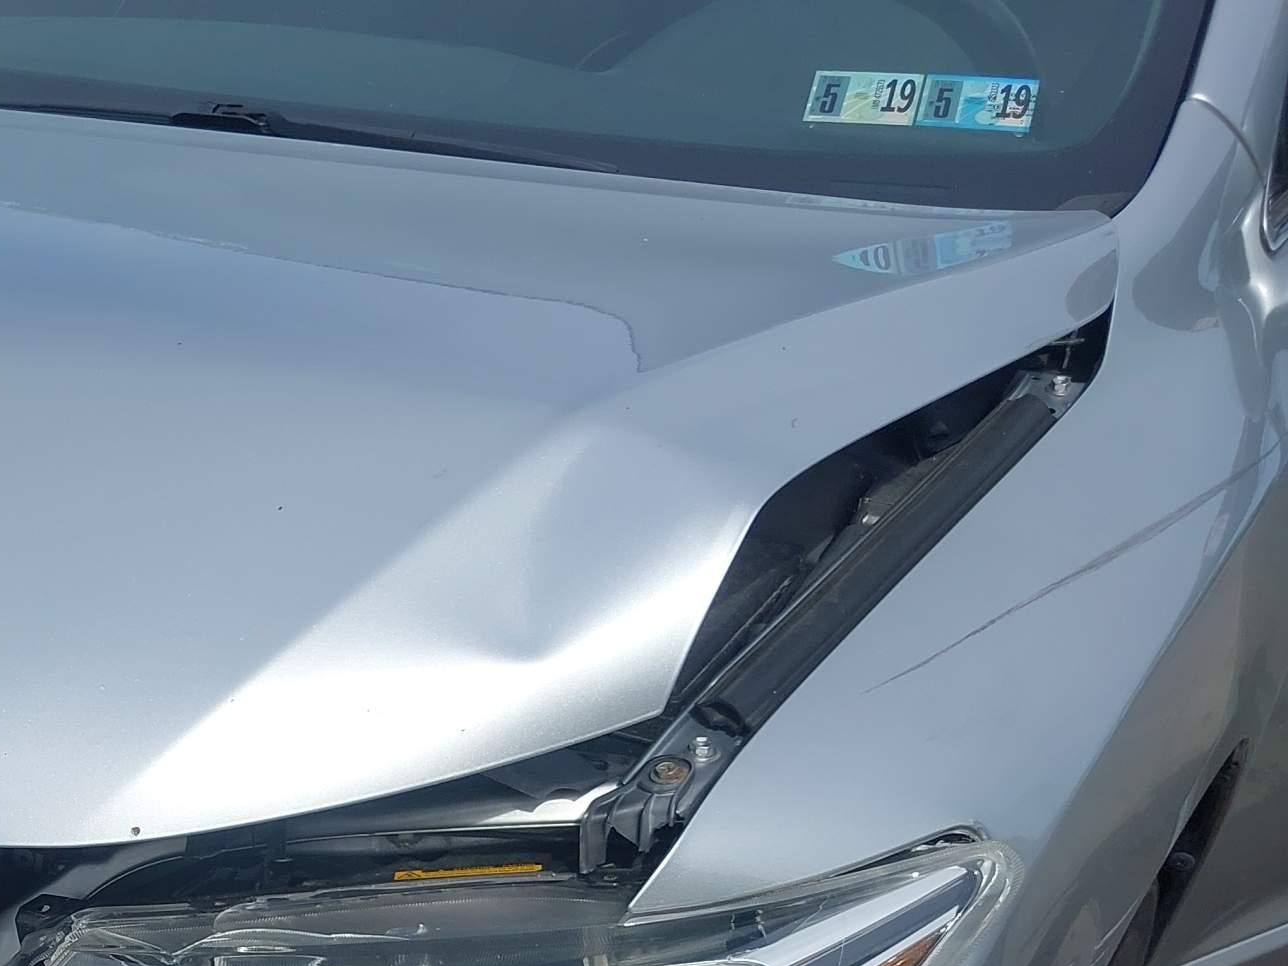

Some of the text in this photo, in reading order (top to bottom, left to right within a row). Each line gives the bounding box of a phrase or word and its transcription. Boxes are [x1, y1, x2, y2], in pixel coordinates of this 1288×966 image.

[819, 83, 841, 114] 5
[880, 79, 916, 113] 19
[933, 88, 954, 119] 5
[996, 84, 1031, 119] 19
